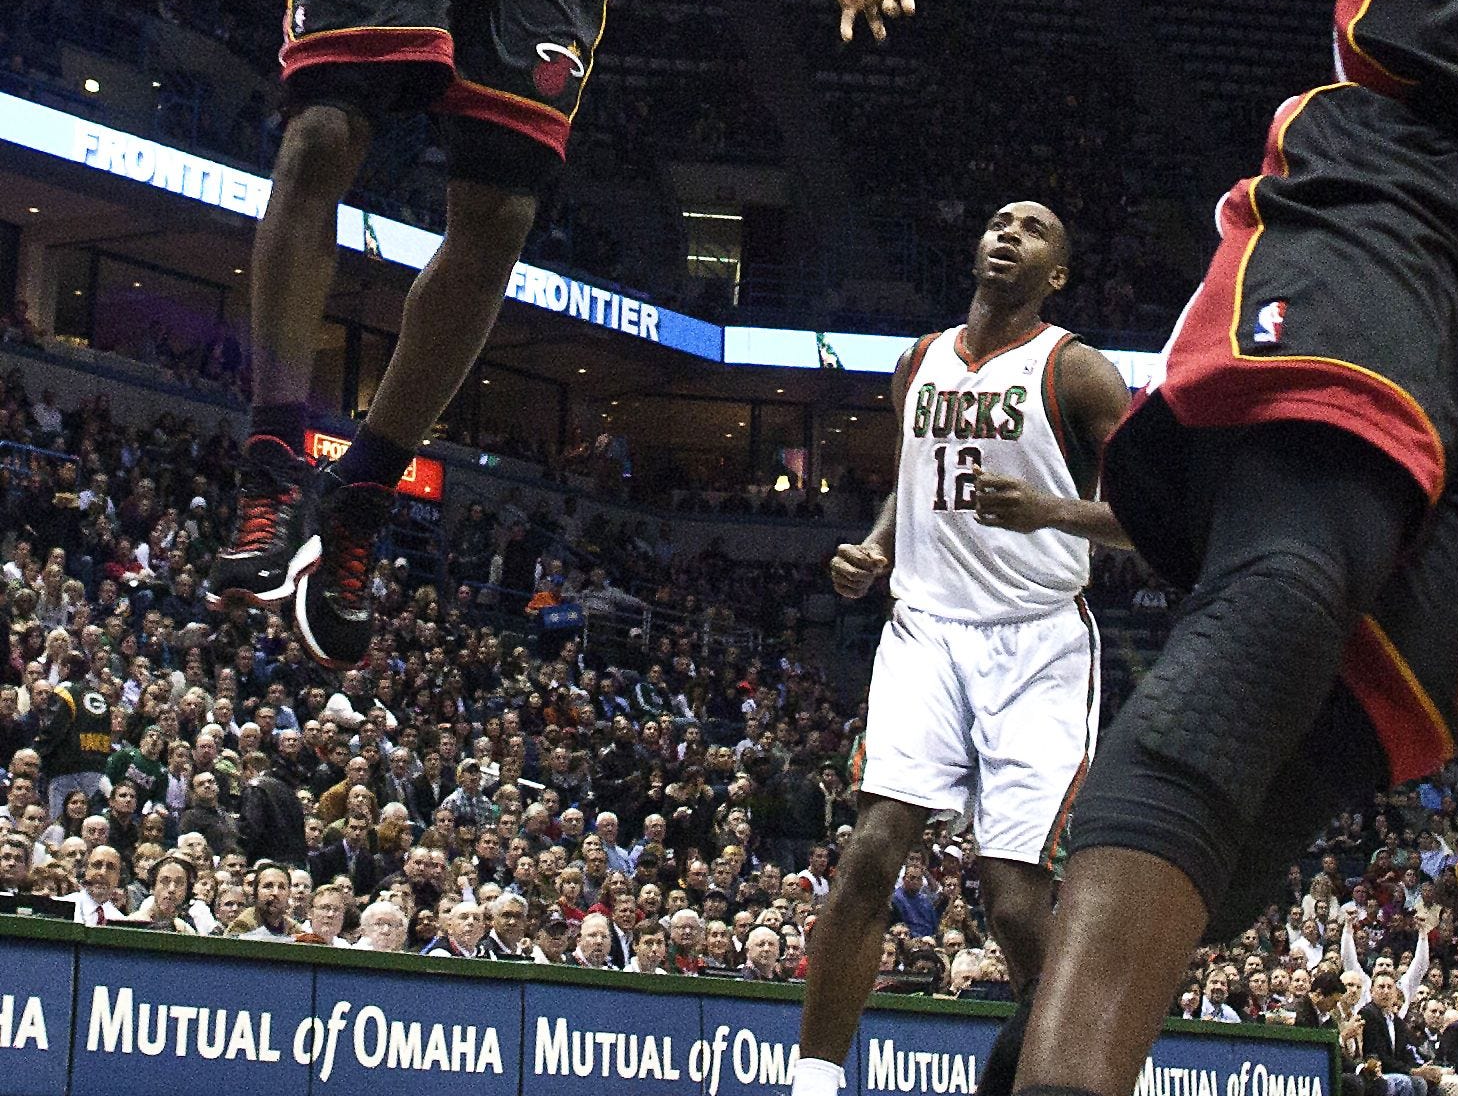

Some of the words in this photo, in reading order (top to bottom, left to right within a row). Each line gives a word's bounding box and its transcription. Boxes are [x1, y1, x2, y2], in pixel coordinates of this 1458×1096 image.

[504, 261, 660, 343] FRONTIER
[913, 382, 1028, 441] BUCKS
[932, 445, 982, 511] 12
[87, 985, 280, 1062] MUTUAL
[293, 1000, 351, 1083] of
[353, 1004, 504, 1074] OMAHA
[534, 1016, 680, 1081] MUTUAL
[688, 1024, 730, 1096] of
[867, 1038, 979, 1095] MUTUAL
